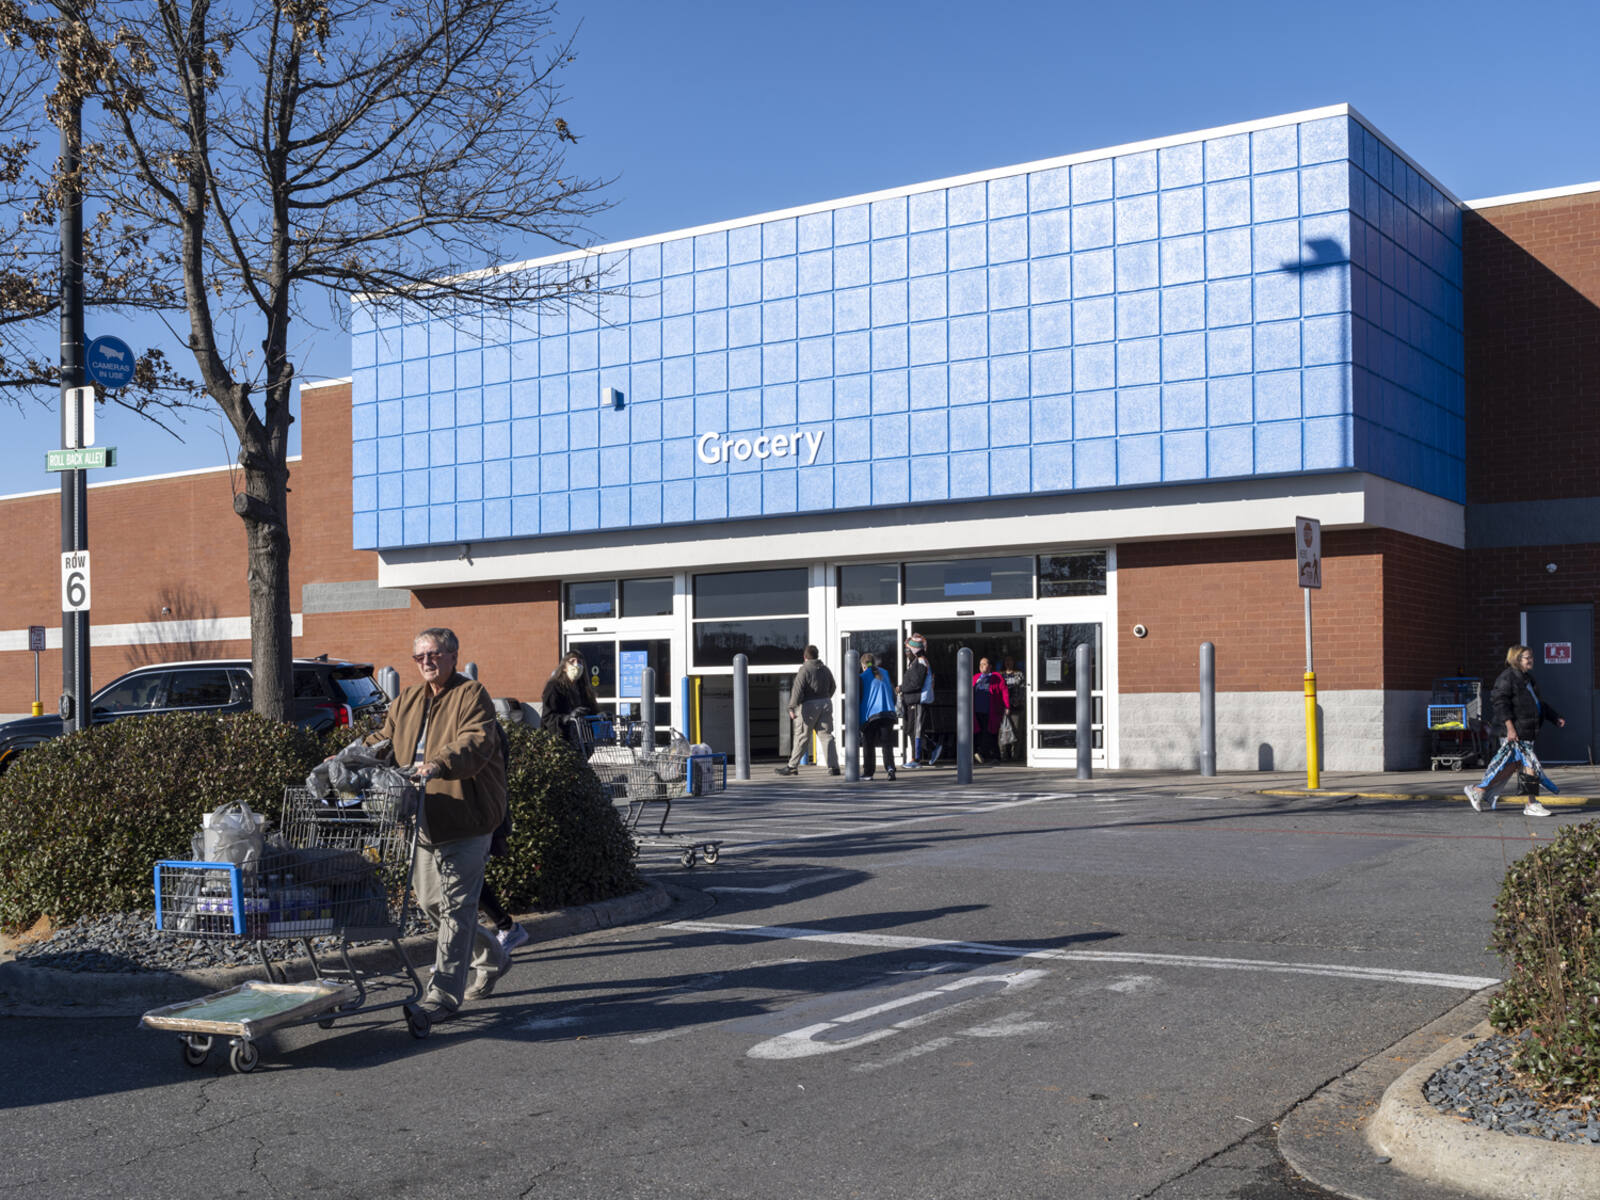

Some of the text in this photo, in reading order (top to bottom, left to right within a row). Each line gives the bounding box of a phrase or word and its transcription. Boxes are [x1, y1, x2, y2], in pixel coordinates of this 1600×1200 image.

[92, 361, 130, 372] CAMERAS
[98, 370, 124, 380] IN USE
[697, 430, 825, 465] Grocery
[49, 451, 104, 466] ROLL BACK ALLEY
[65, 555, 86, 569] ROW
[66, 571, 86, 607] 6
